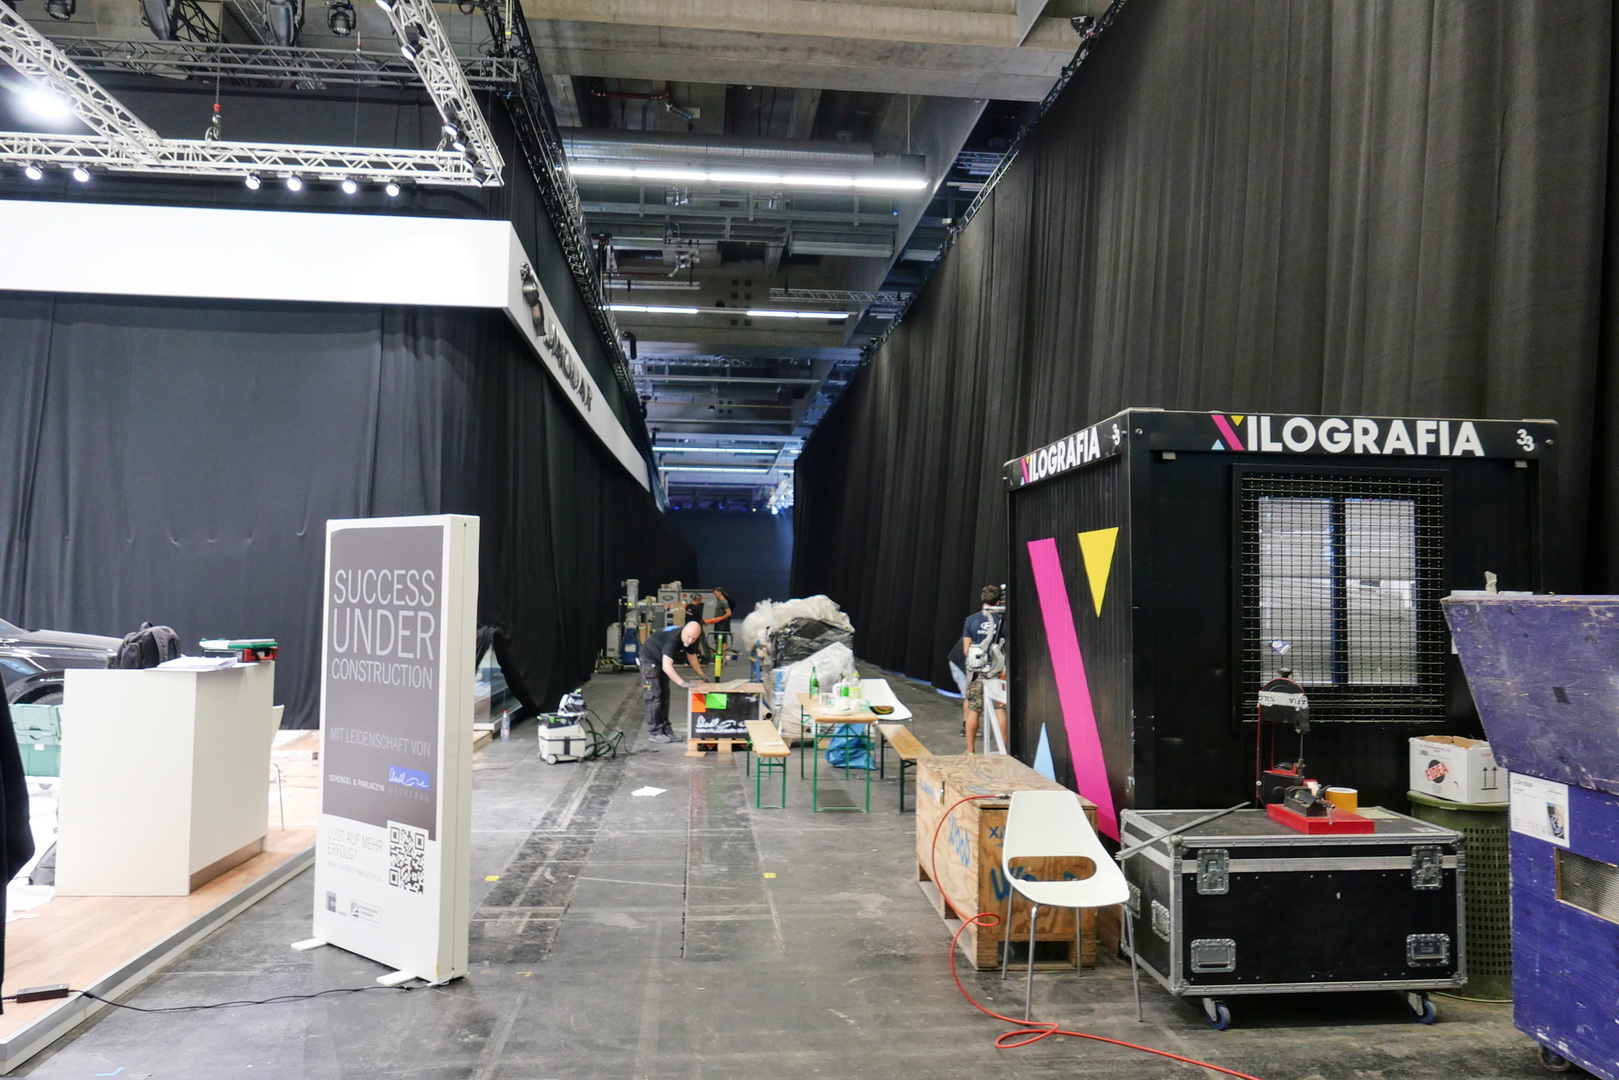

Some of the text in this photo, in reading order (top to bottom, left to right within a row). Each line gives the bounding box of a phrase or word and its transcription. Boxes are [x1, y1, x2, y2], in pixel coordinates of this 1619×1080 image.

[543, 317, 592, 412] JAGUAR
[1211, 414, 1485, 456] XILOGRAFIA
[1020, 426, 1100, 486] XILOGRAFIA
[334, 569, 435, 607] SUCCESS
[333, 607, 435, 660] UNDER
[331, 658, 433, 690] CONSTRUCTION
[330, 726, 431, 757] MIT LEIDENSCHAFT VON
[328, 773, 352, 786] SCHENDEL
[1425, 762, 1449, 781] FIDEA
[327, 827, 384, 853] LUST AUF MEHR
[327, 841, 357, 861] ERFOLG?
